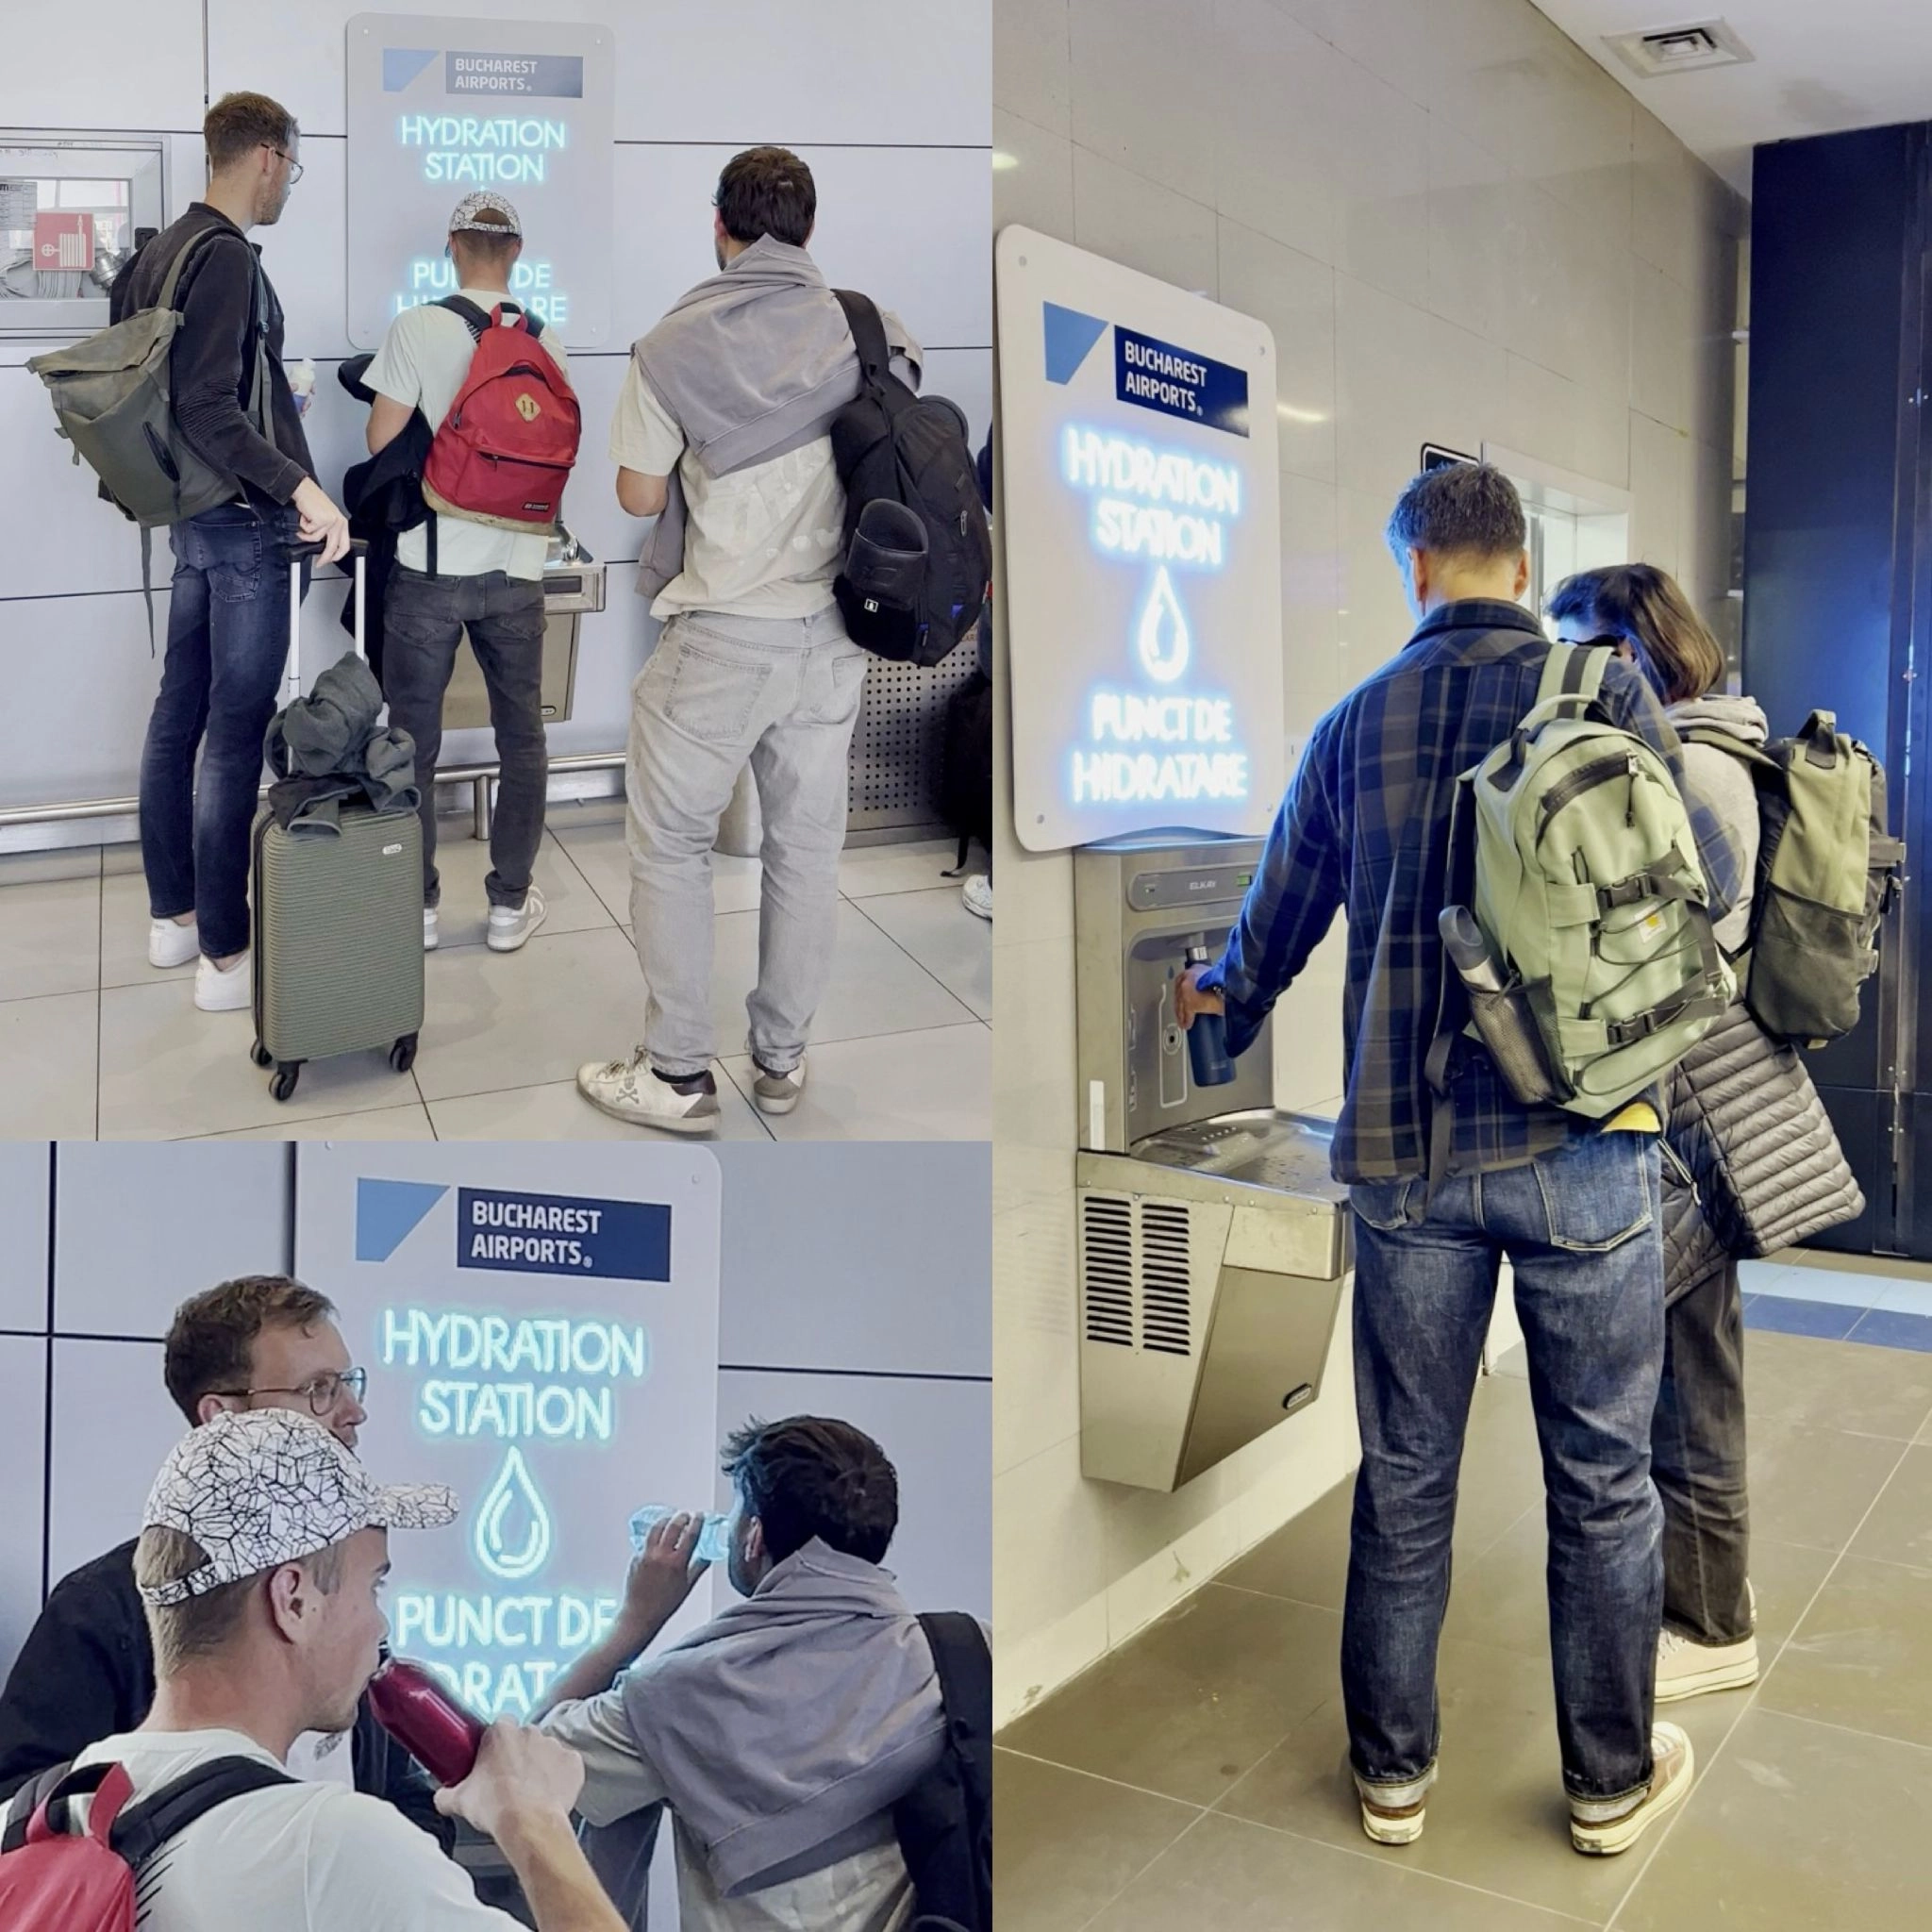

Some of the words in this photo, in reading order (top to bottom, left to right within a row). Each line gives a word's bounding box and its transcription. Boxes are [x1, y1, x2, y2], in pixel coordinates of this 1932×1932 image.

[455, 58, 538, 75] BUCHAREST
[400, 116, 566, 148] HYDRATION
[425, 153, 544, 181] STATION
[515, 263, 551, 288] DE
[1124, 341, 1208, 387] BUCHAREST
[1066, 428, 1240, 515] HYDRATION
[1096, 498, 1222, 564] STATION
[1092, 692, 1192, 741] PUNCT
[1193, 698, 1233, 742] DE
[1073, 751, 1248, 803] HIDRATARE
[472, 1201, 602, 1235] BUCHAREST
[383, 1308, 644, 1378] HYDRATION
[420, 1380, 611, 1441] STATION
[396, 1594, 553, 1647] PUNCT
